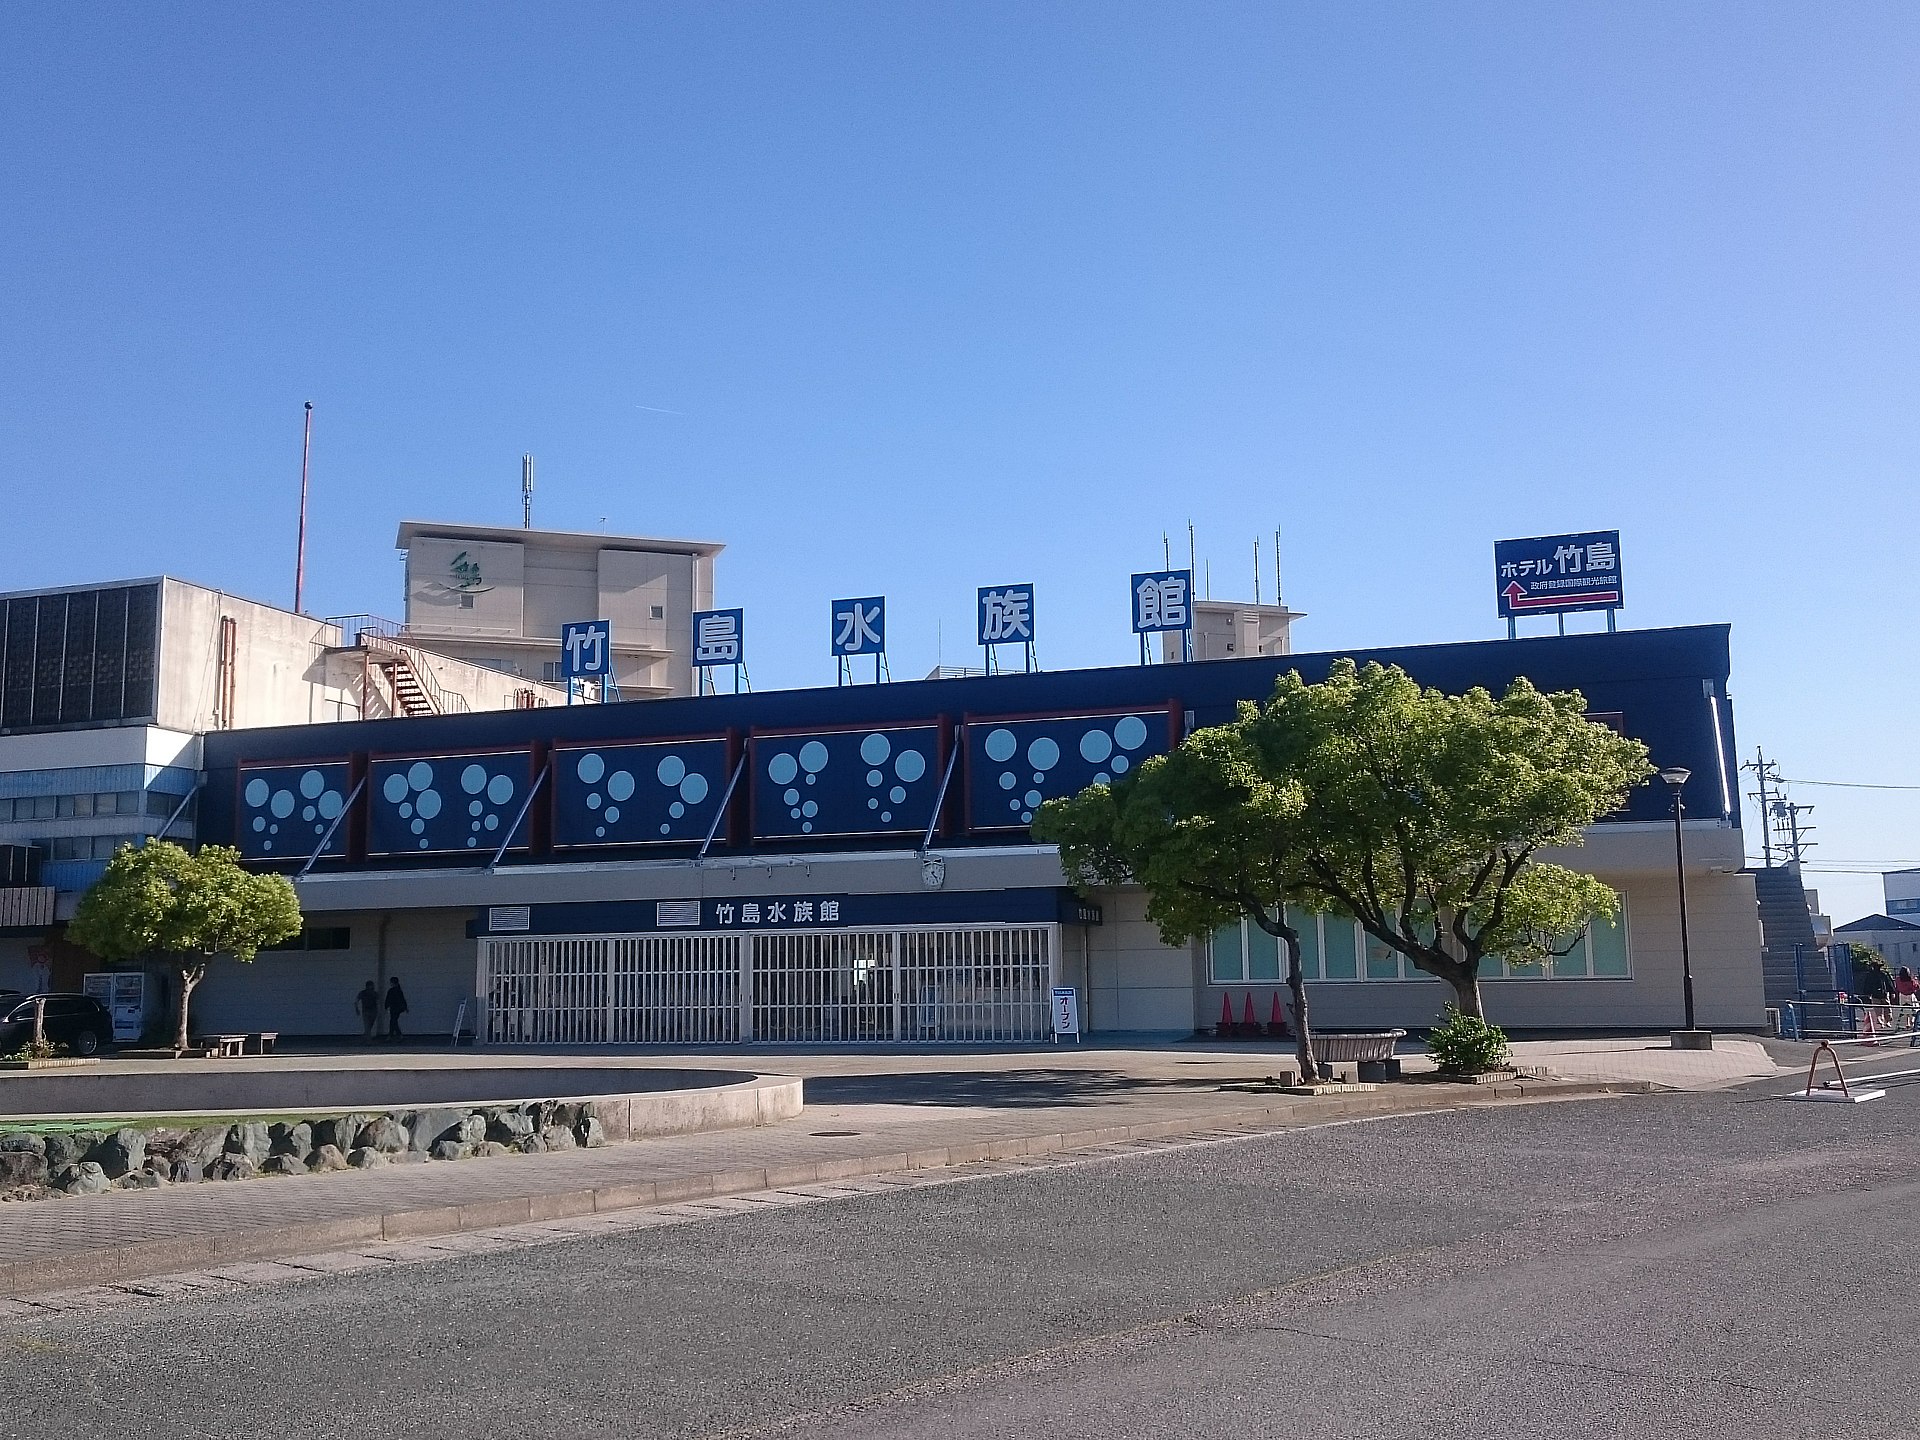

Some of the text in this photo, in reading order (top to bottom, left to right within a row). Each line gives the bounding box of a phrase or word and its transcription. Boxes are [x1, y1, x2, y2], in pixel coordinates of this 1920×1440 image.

[1501, 542, 1616, 578] ホテル竹島
[715, 900, 839, 924] 竹島水族館
